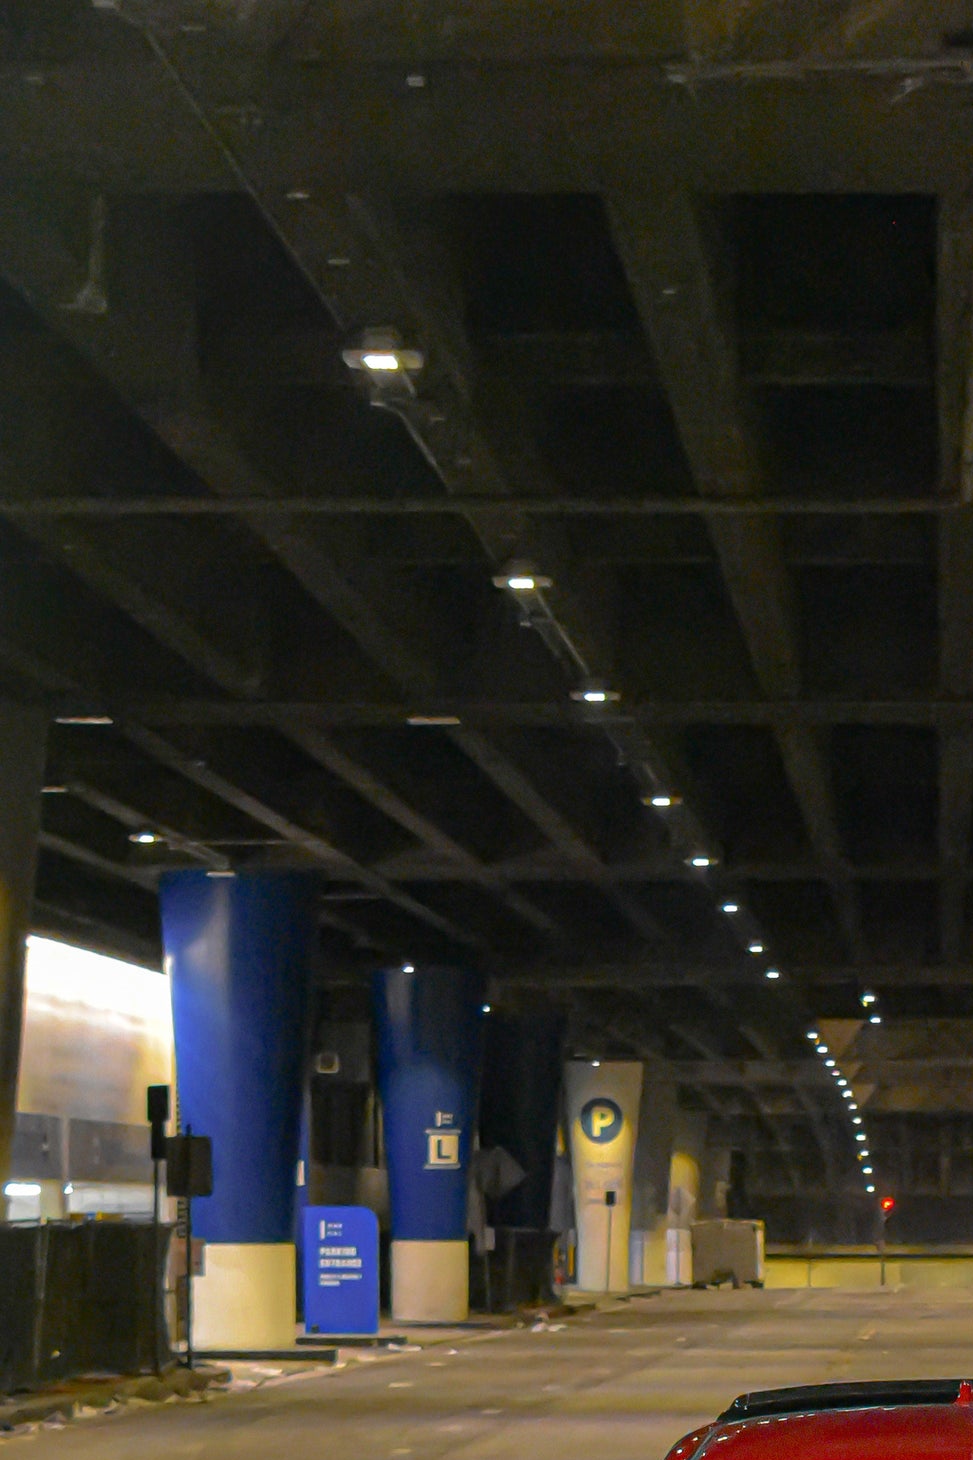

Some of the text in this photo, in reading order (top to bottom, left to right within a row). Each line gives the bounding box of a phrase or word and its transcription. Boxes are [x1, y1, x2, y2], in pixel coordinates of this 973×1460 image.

[591, 1105, 615, 1137] P
[437, 1139, 452, 1159] L
[319, 1247, 357, 1256] PARKING
